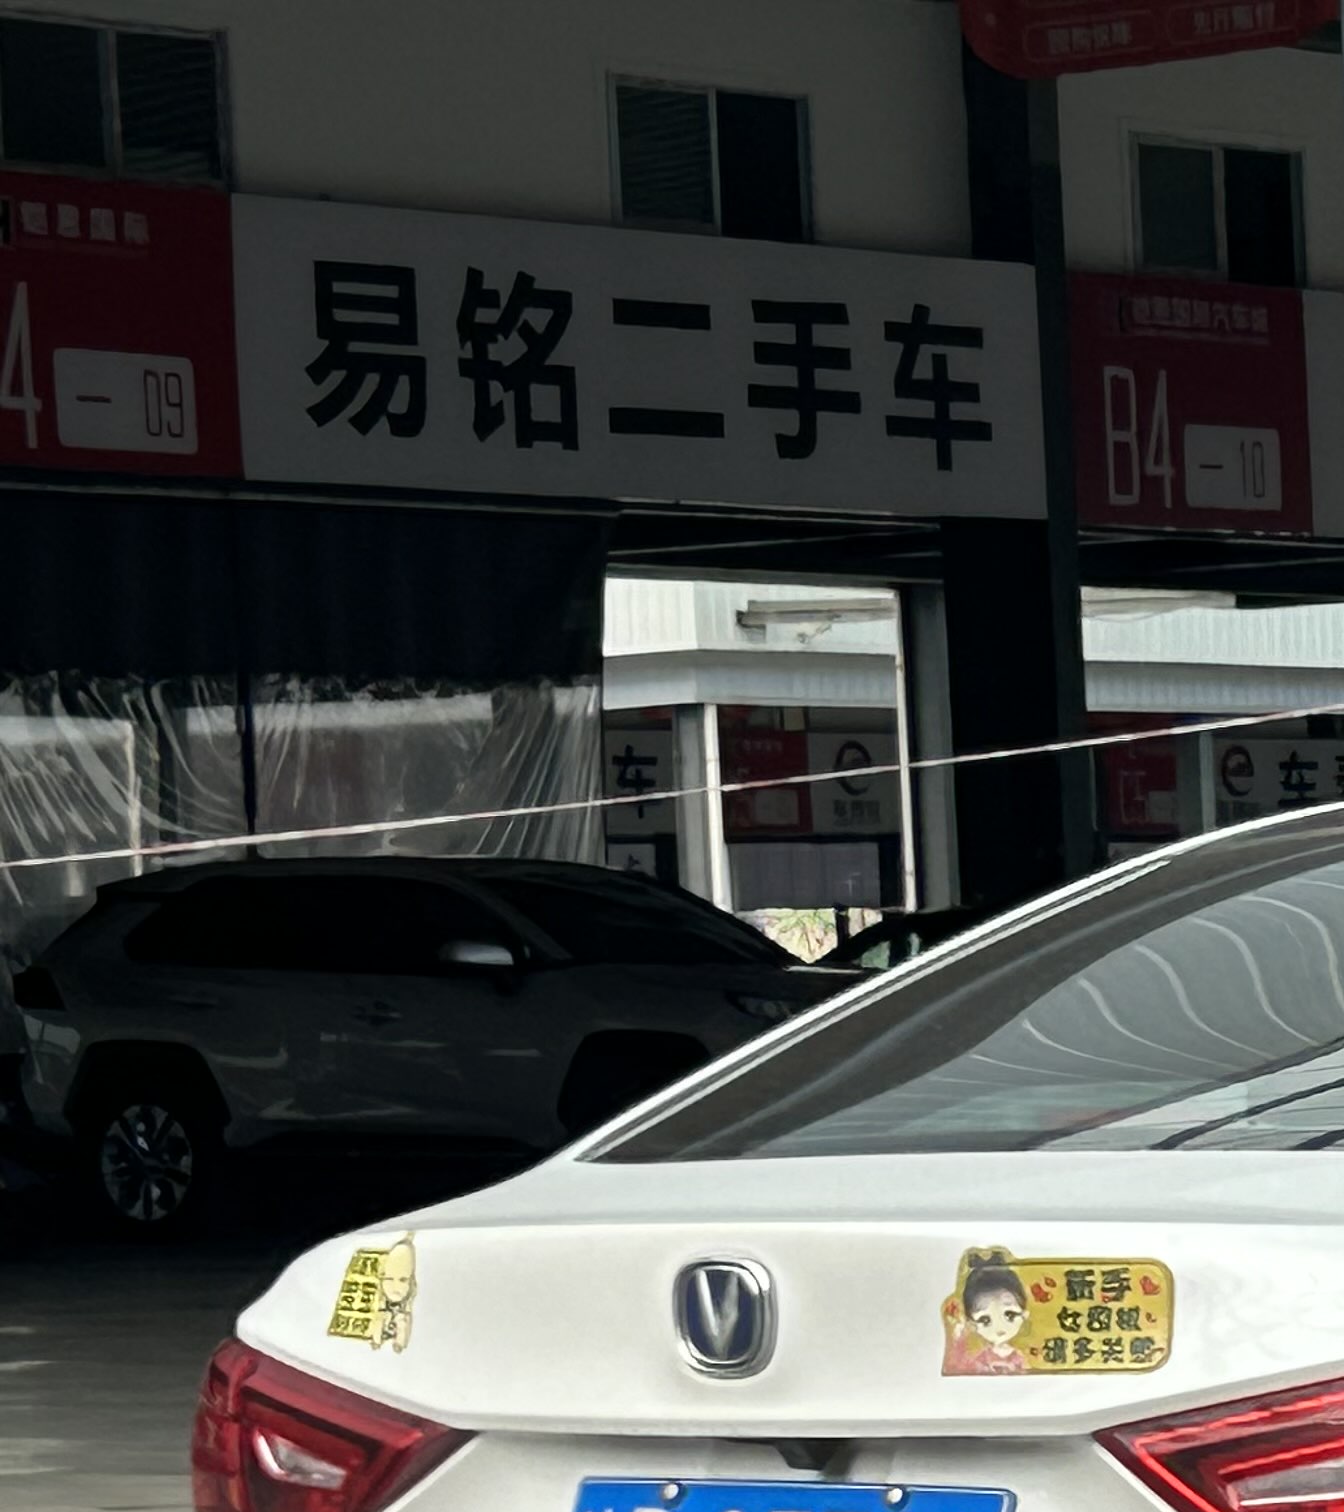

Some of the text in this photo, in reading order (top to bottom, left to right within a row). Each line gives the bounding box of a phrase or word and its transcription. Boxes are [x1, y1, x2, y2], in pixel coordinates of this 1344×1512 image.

[304, 259, 993, 471] 易铭二手车
